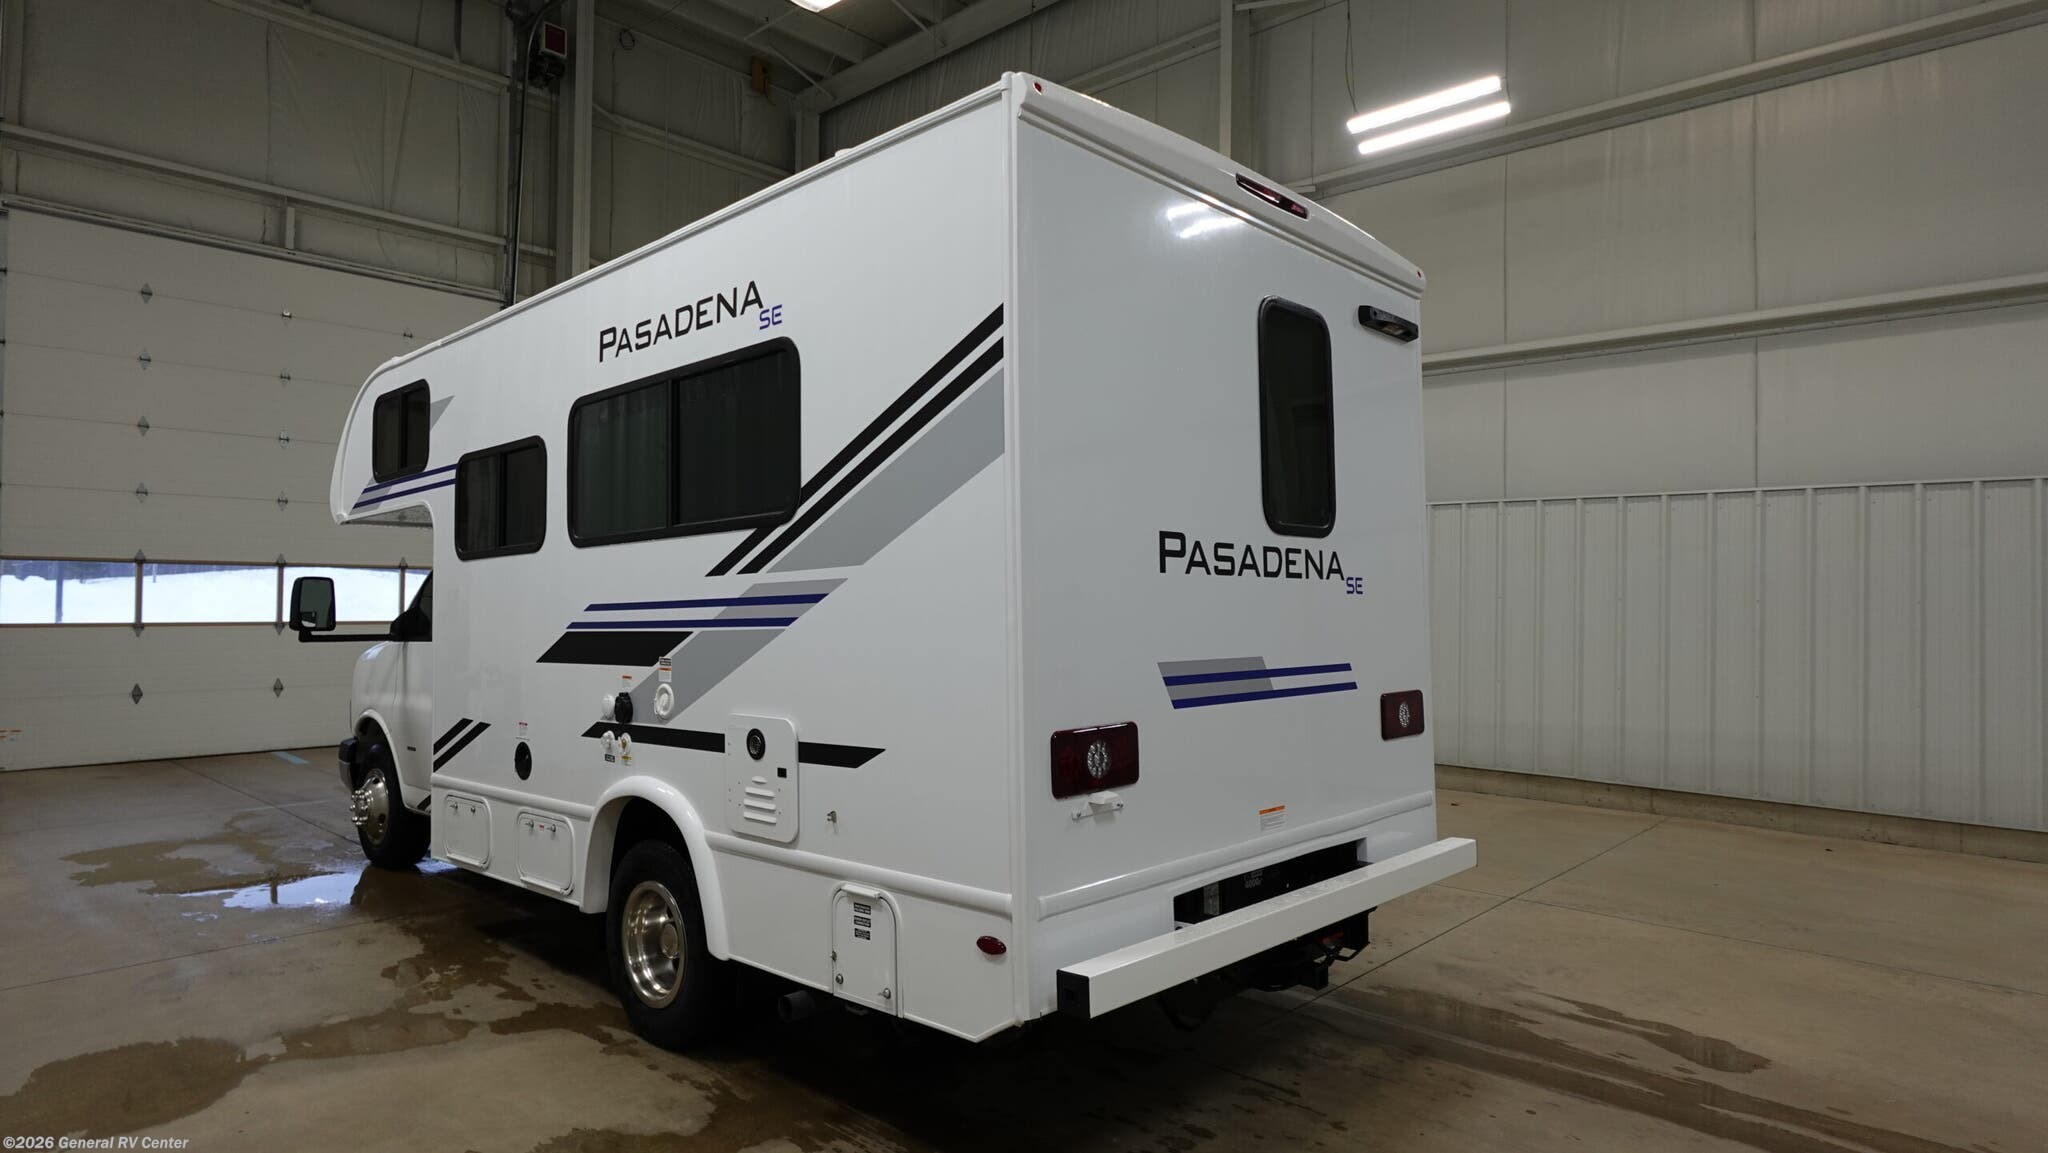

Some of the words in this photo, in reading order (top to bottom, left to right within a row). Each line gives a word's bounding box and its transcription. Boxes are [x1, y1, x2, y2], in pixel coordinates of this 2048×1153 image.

[599, 280, 764, 363] PASADENA
[759, 304, 783, 330] SE
[1159, 530, 1345, 581] PASADENA
[1346, 576, 1364, 595] SE
